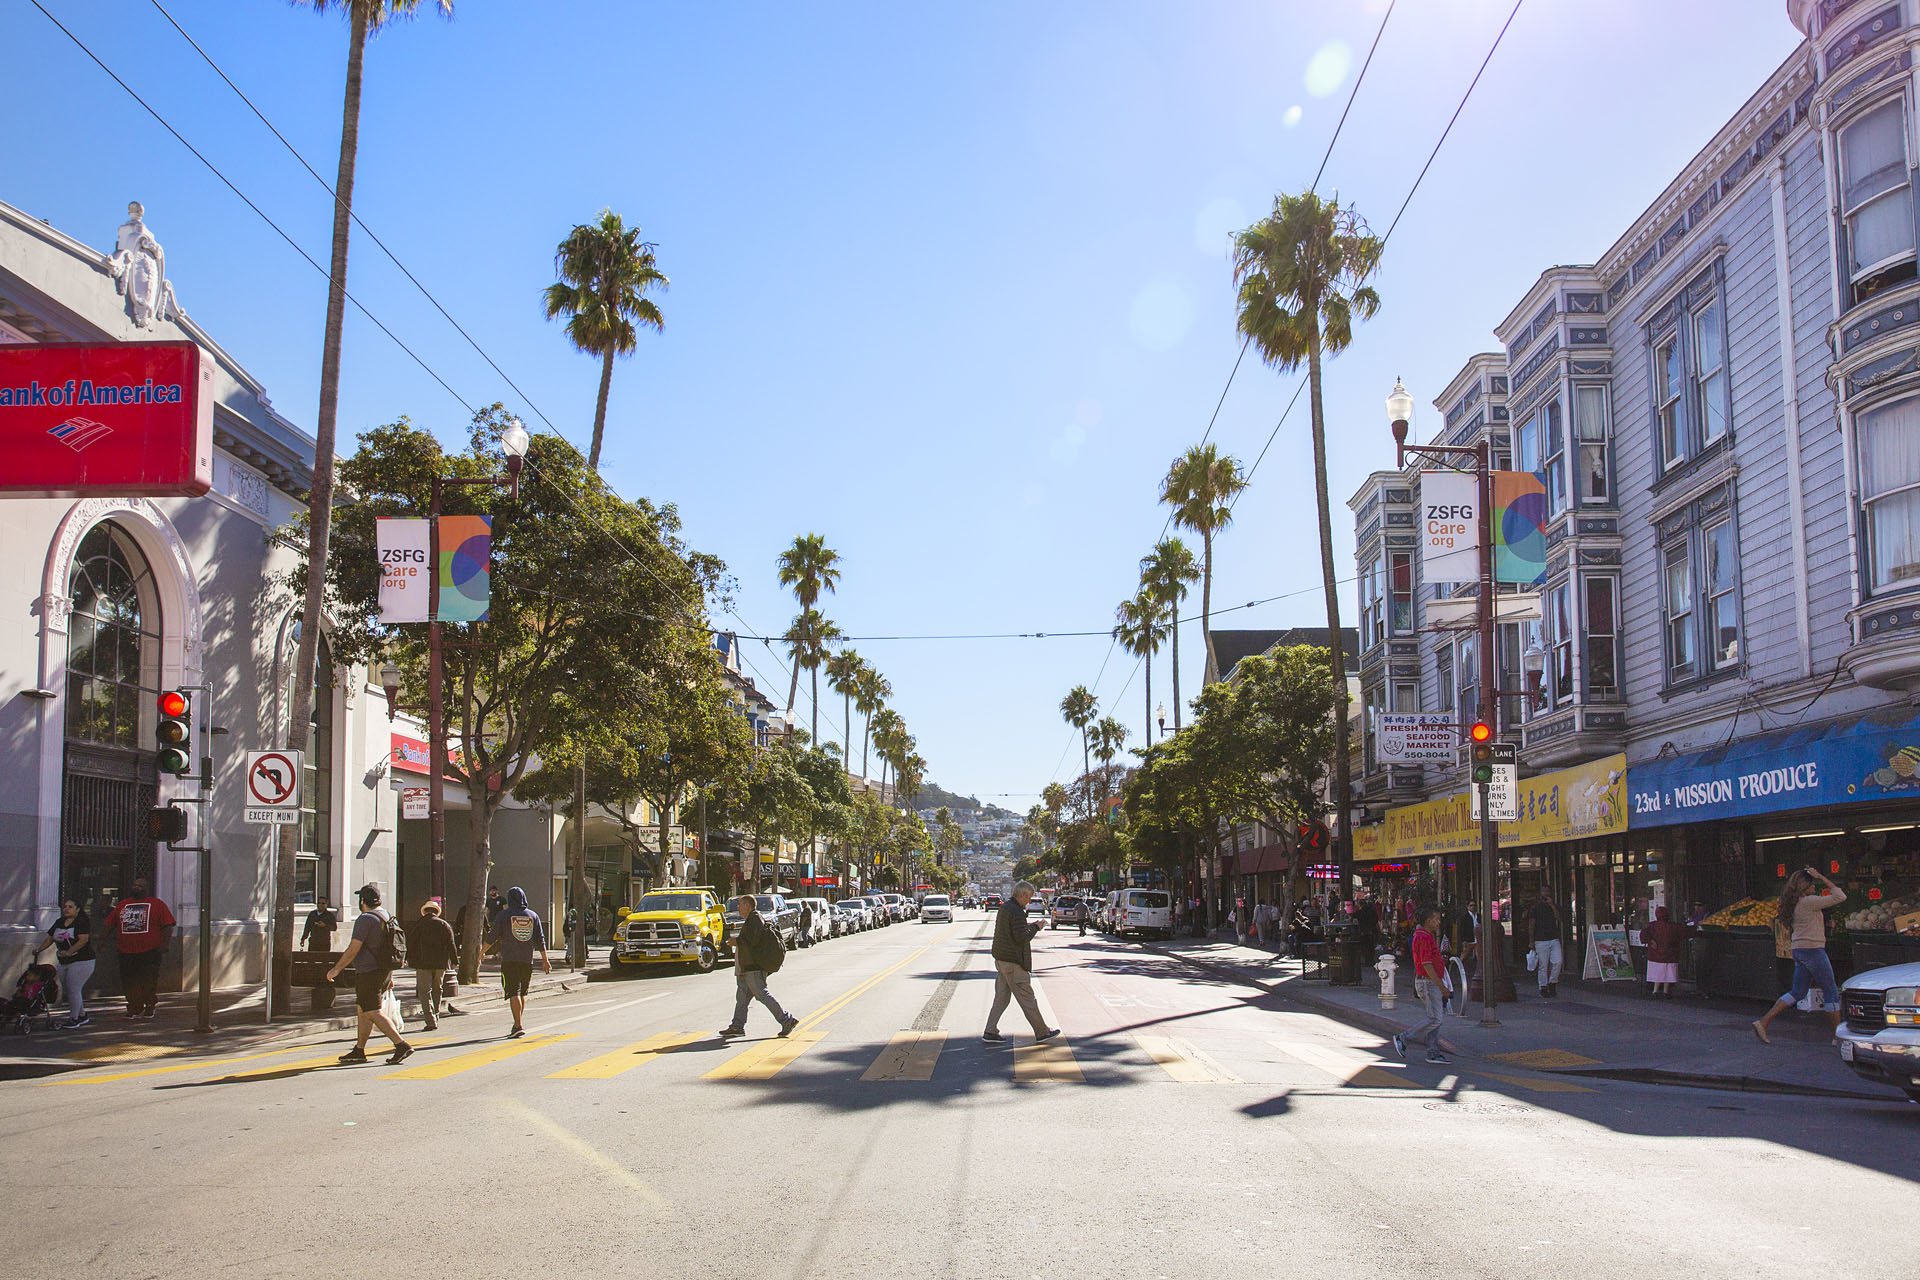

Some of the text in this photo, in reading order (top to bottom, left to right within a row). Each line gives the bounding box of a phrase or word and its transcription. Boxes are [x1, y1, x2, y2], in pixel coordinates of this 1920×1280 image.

[0, 379, 182, 406] ank of America
[1427, 505, 1473, 520] ZSFG
[1427, 521, 1466, 535] Care
[1428, 536, 1454, 548] .org
[382, 549, 425, 562] ZSFG
[383, 563, 418, 577] Care
[382, 579, 406, 590] .org
[402, 742, 421, 761] Bank
[421, 750, 430, 766] of
[1404, 751, 1451, 759] 550-8044
[1634, 762, 1819, 814] 23rd & MISSION PRODUCE
[248, 811, 294, 821] EXCEPT MUNI
[1400, 813, 1417, 840] Fresh
[1418, 810, 1433, 839] Meat
[1434, 804, 1459, 836] Seafood
[1498, 832, 1520, 843] Seafood
